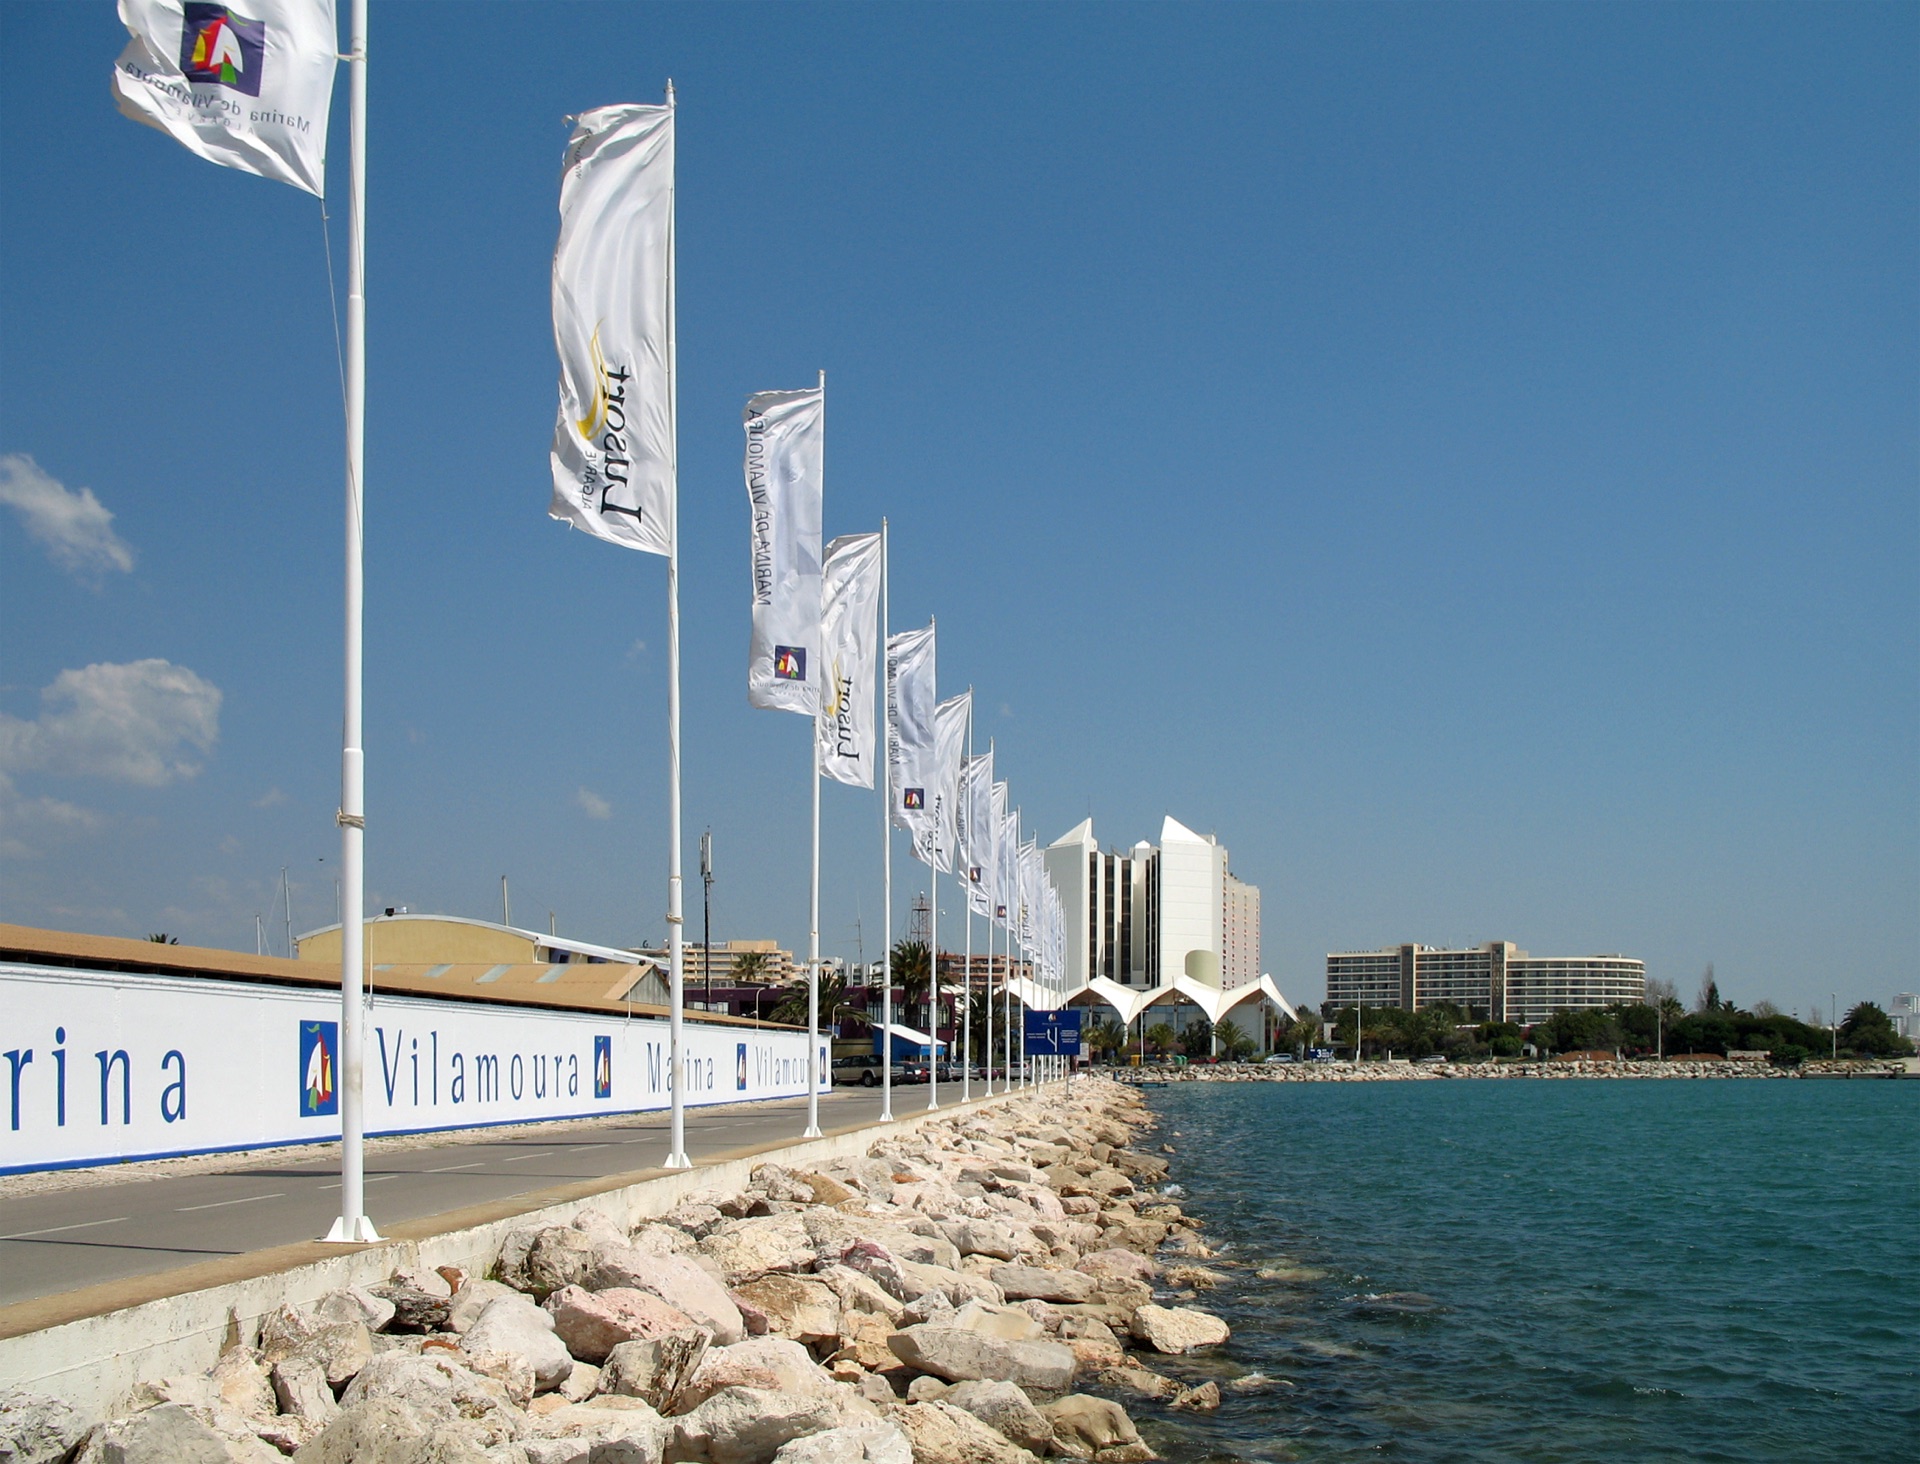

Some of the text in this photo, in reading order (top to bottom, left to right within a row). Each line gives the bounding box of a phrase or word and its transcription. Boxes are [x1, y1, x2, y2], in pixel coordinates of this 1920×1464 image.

[3, 1026, 579, 1131] rina Vilamoura
[647, 1042, 810, 1094] Maina Vilamour
